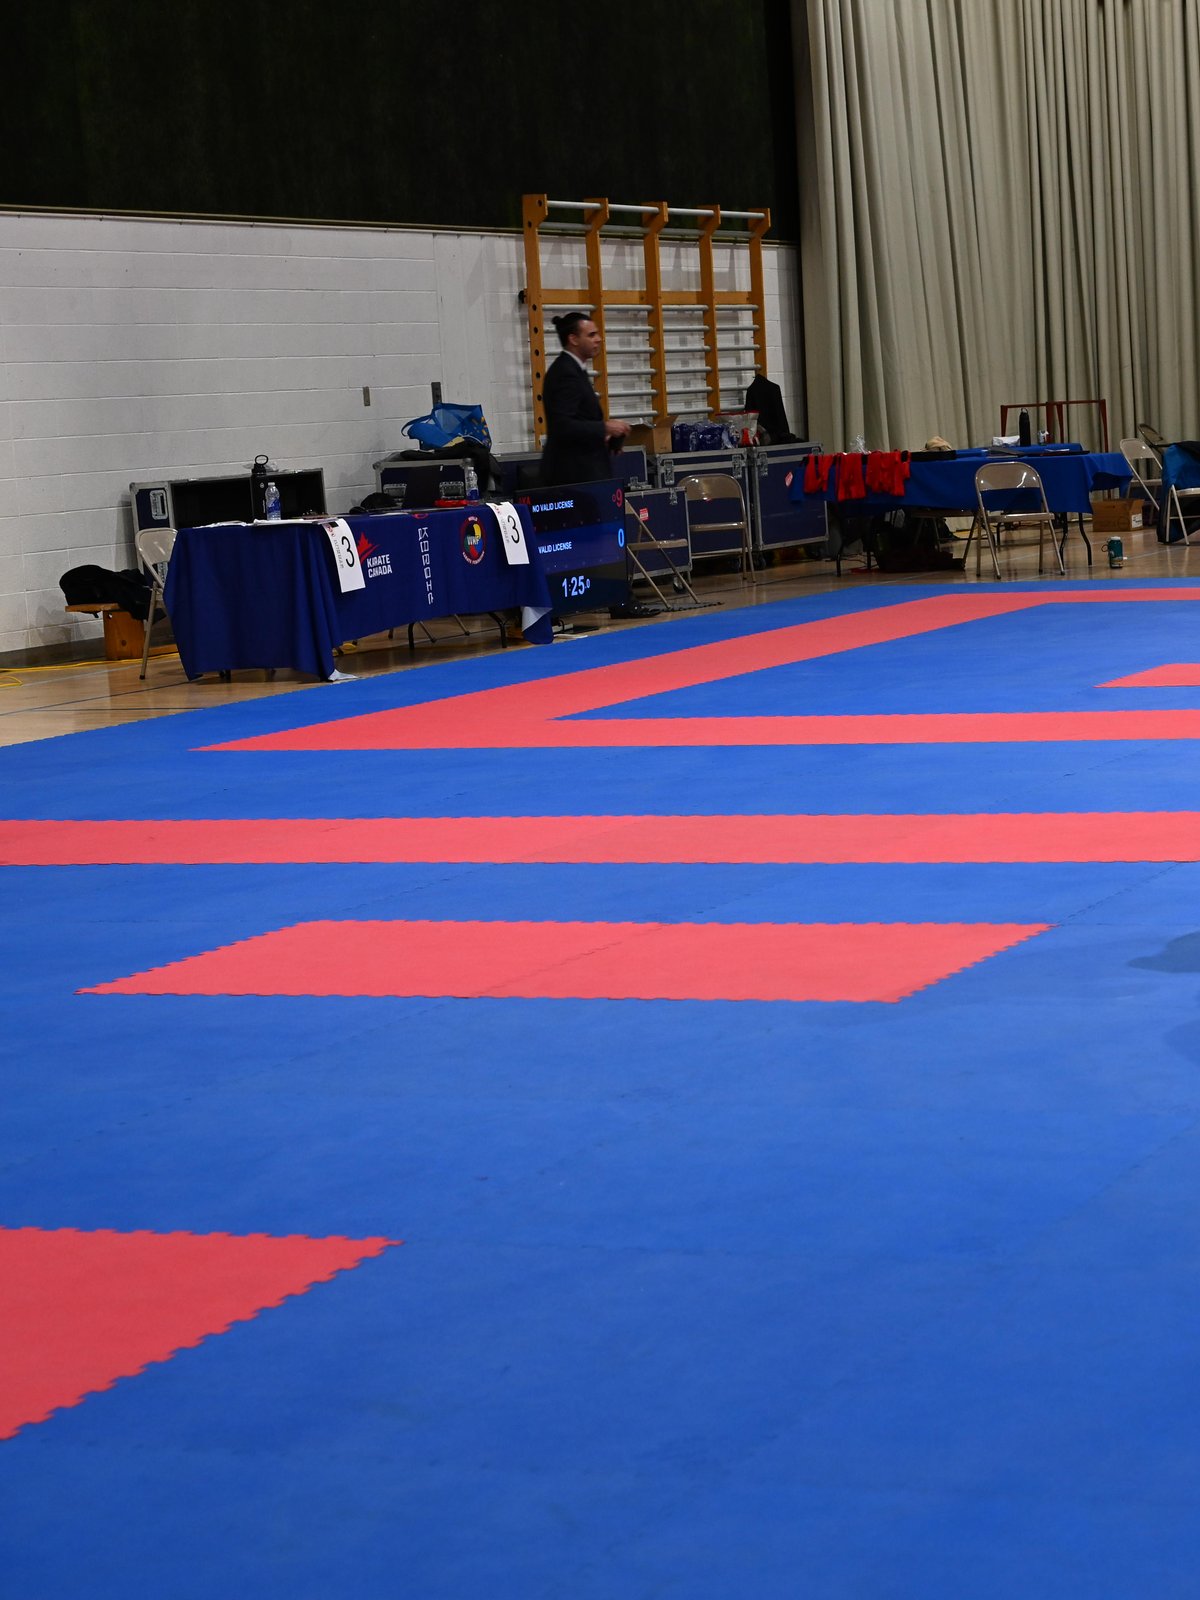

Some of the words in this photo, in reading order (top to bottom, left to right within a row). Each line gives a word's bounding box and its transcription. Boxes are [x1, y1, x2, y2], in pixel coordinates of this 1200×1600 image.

[532, 504, 540, 513] NO
[540, 502, 554, 512] VALID
[554, 500, 574, 510] LICENSE
[507, 514, 520, 544] 3
[617, 528, 625, 548] 0
[341, 535, 355, 568] 3
[538, 544, 553, 554] VALID
[553, 541, 573, 552] LICENSE
